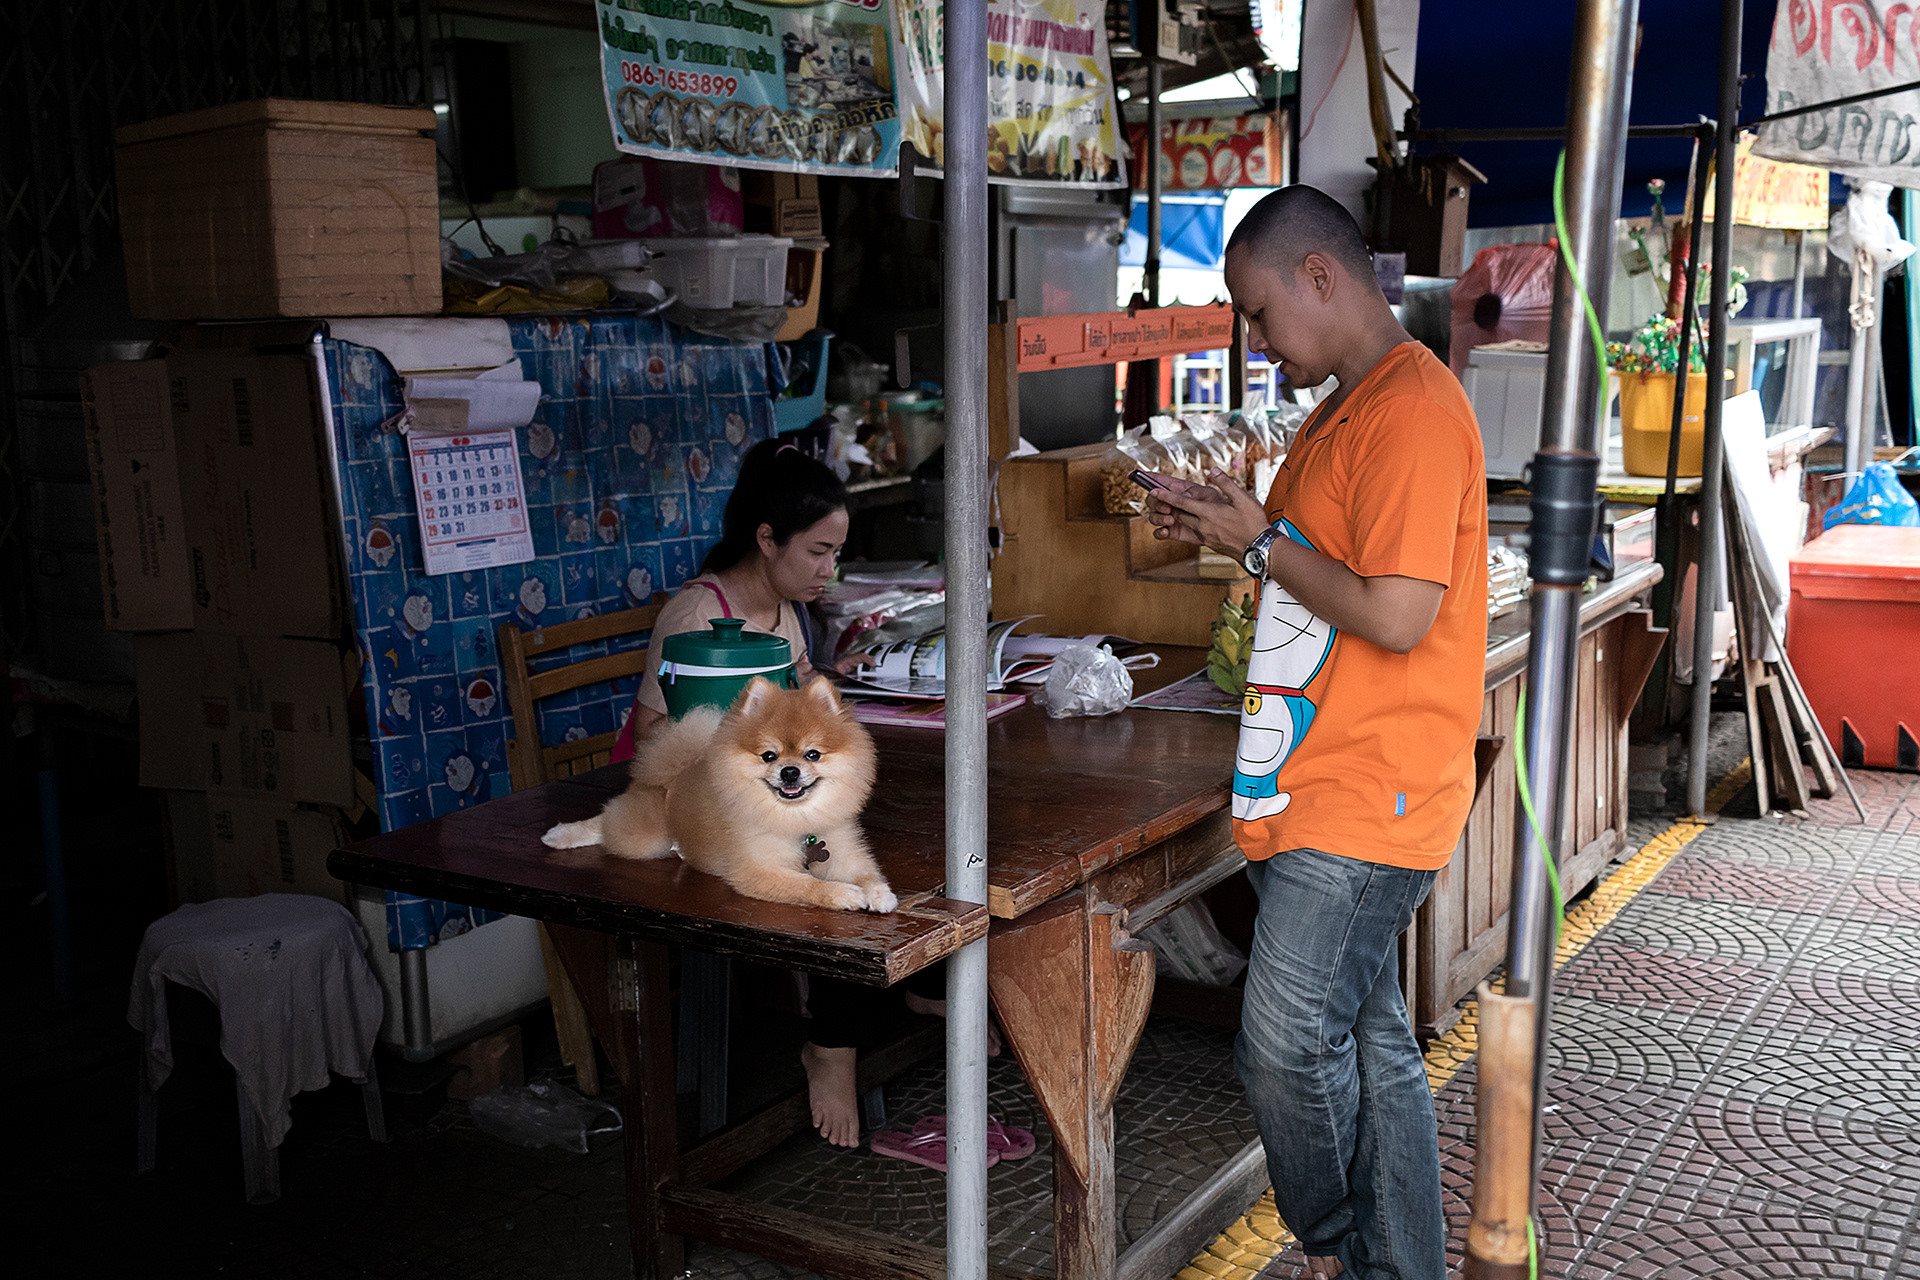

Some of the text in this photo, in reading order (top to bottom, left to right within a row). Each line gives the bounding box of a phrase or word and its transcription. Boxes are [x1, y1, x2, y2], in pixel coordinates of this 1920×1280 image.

[621, 60, 738, 98] 086-7653899
[420, 456, 424, 466] 1
[434, 454, 439, 465] 2
[448, 453, 453, 464] 3
[462, 451, 466, 462] 4
[475, 451, 480, 461] 5
[489, 449, 495, 460] 6
[504, 448, 507, 458] 7
[422, 464, 512, 484] 8 9 10 11 12 13 14
[423, 481, 514, 501] 15 16 17 18 19 20 21
[426, 498, 518, 519] 22 23 24 25 26 27 28
[204, 442, 237, 624] Peanut Butter
[428, 522, 465, 536] 29 30 31
